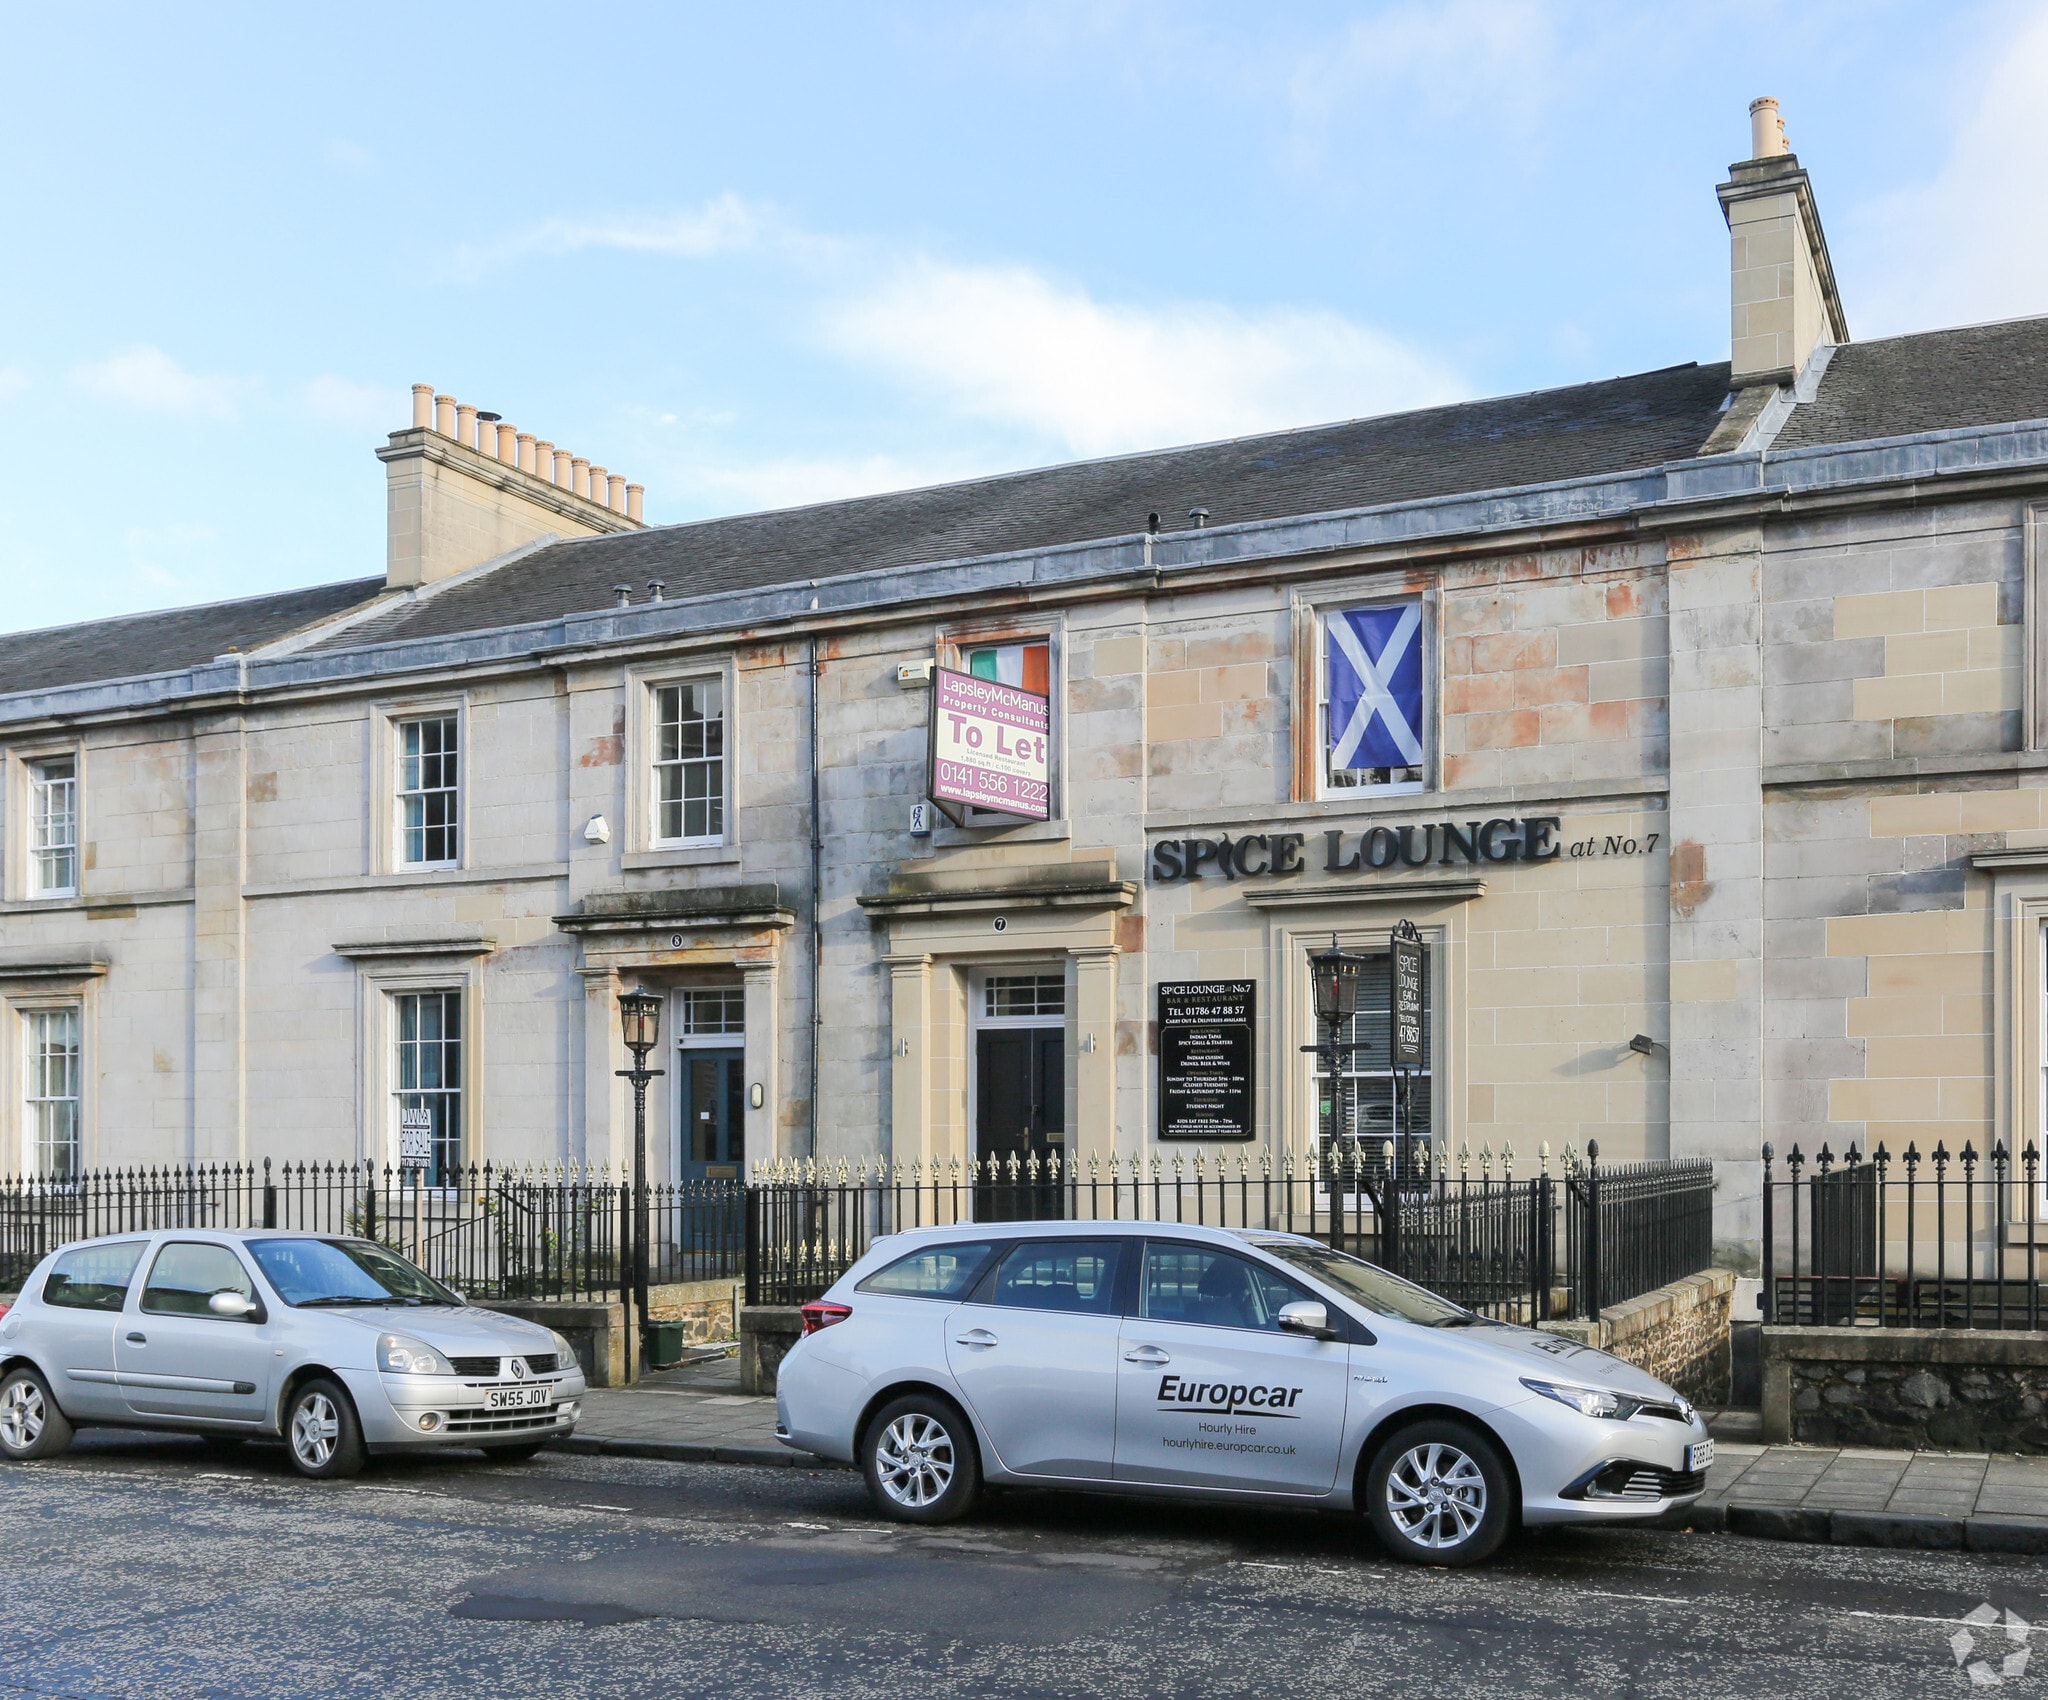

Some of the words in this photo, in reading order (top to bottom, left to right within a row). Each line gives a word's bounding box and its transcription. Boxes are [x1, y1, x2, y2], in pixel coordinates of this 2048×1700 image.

[943, 673, 1049, 717] LapsleyMcManus
[943, 695, 987, 716] Property
[991, 707, 1049, 730] Consultants
[947, 712, 983, 748] To
[996, 726, 1045, 764] Let
[967, 748, 993, 760] Licensed
[994, 754, 1026, 767] Restaurant
[940, 762, 974, 786] 0141
[978, 771, 1008, 794] 556
[1013, 779, 1048, 802] 1222
[940, 784, 1048, 814] www.lapsleymcmanus.com
[1322, 816, 1561, 872] LOUNGE
[1569, 833, 1596, 858] at
[1602, 833, 1660, 857] No.7
[1399, 955, 1418, 974] SPICE
[1186, 985, 1225, 994] LOUNGE
[1232, 984, 1251, 993] No.7
[1186, 1007, 1209, 1015] 01786
[1223, 1006, 1233, 1014] 88
[1235, 1006, 1244, 1014] 57
[402, 1130, 414, 1154] FOR
[490, 1390, 524, 1407] SW55
[526, 1389, 547, 1404] JOV
[1157, 1375, 1304, 1415] Europcar
[1199, 1422, 1233, 1436] Hourly
[1235, 1424, 1257, 1435] Hire
[1162, 1436, 1296, 1456] hourlyhire.europcar.co.uk
